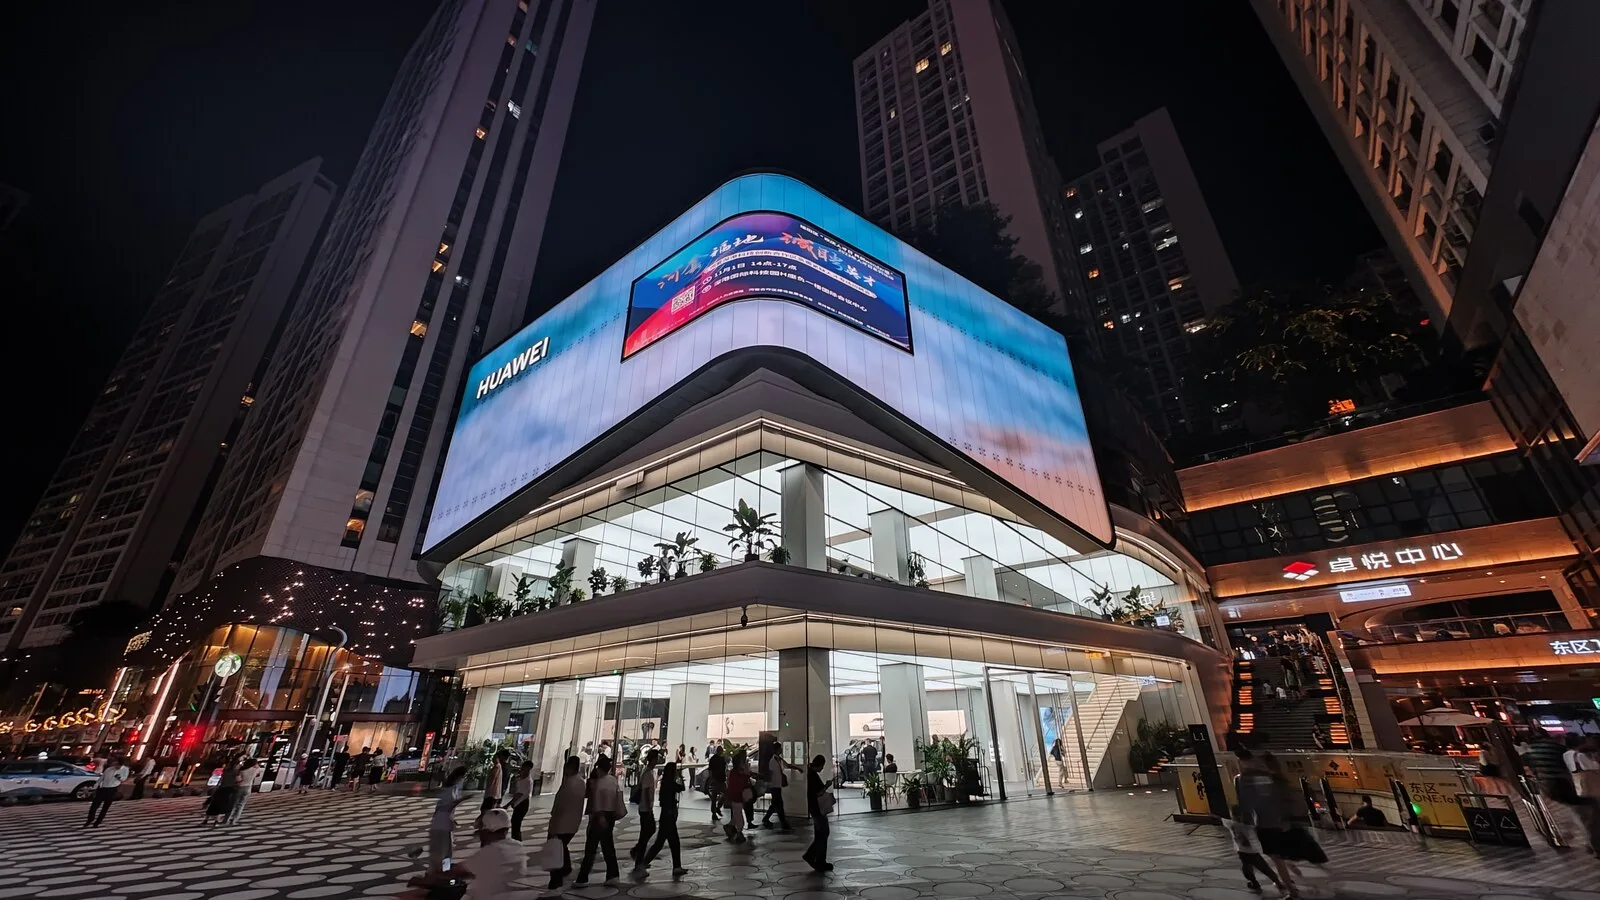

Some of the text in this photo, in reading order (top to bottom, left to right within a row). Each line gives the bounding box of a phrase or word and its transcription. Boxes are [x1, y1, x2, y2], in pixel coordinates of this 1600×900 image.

[476, 336, 549, 399] HUAWEI
[1328, 542, 1464, 573] 卓悦中心
[1409, 782, 1439, 794] 东区
